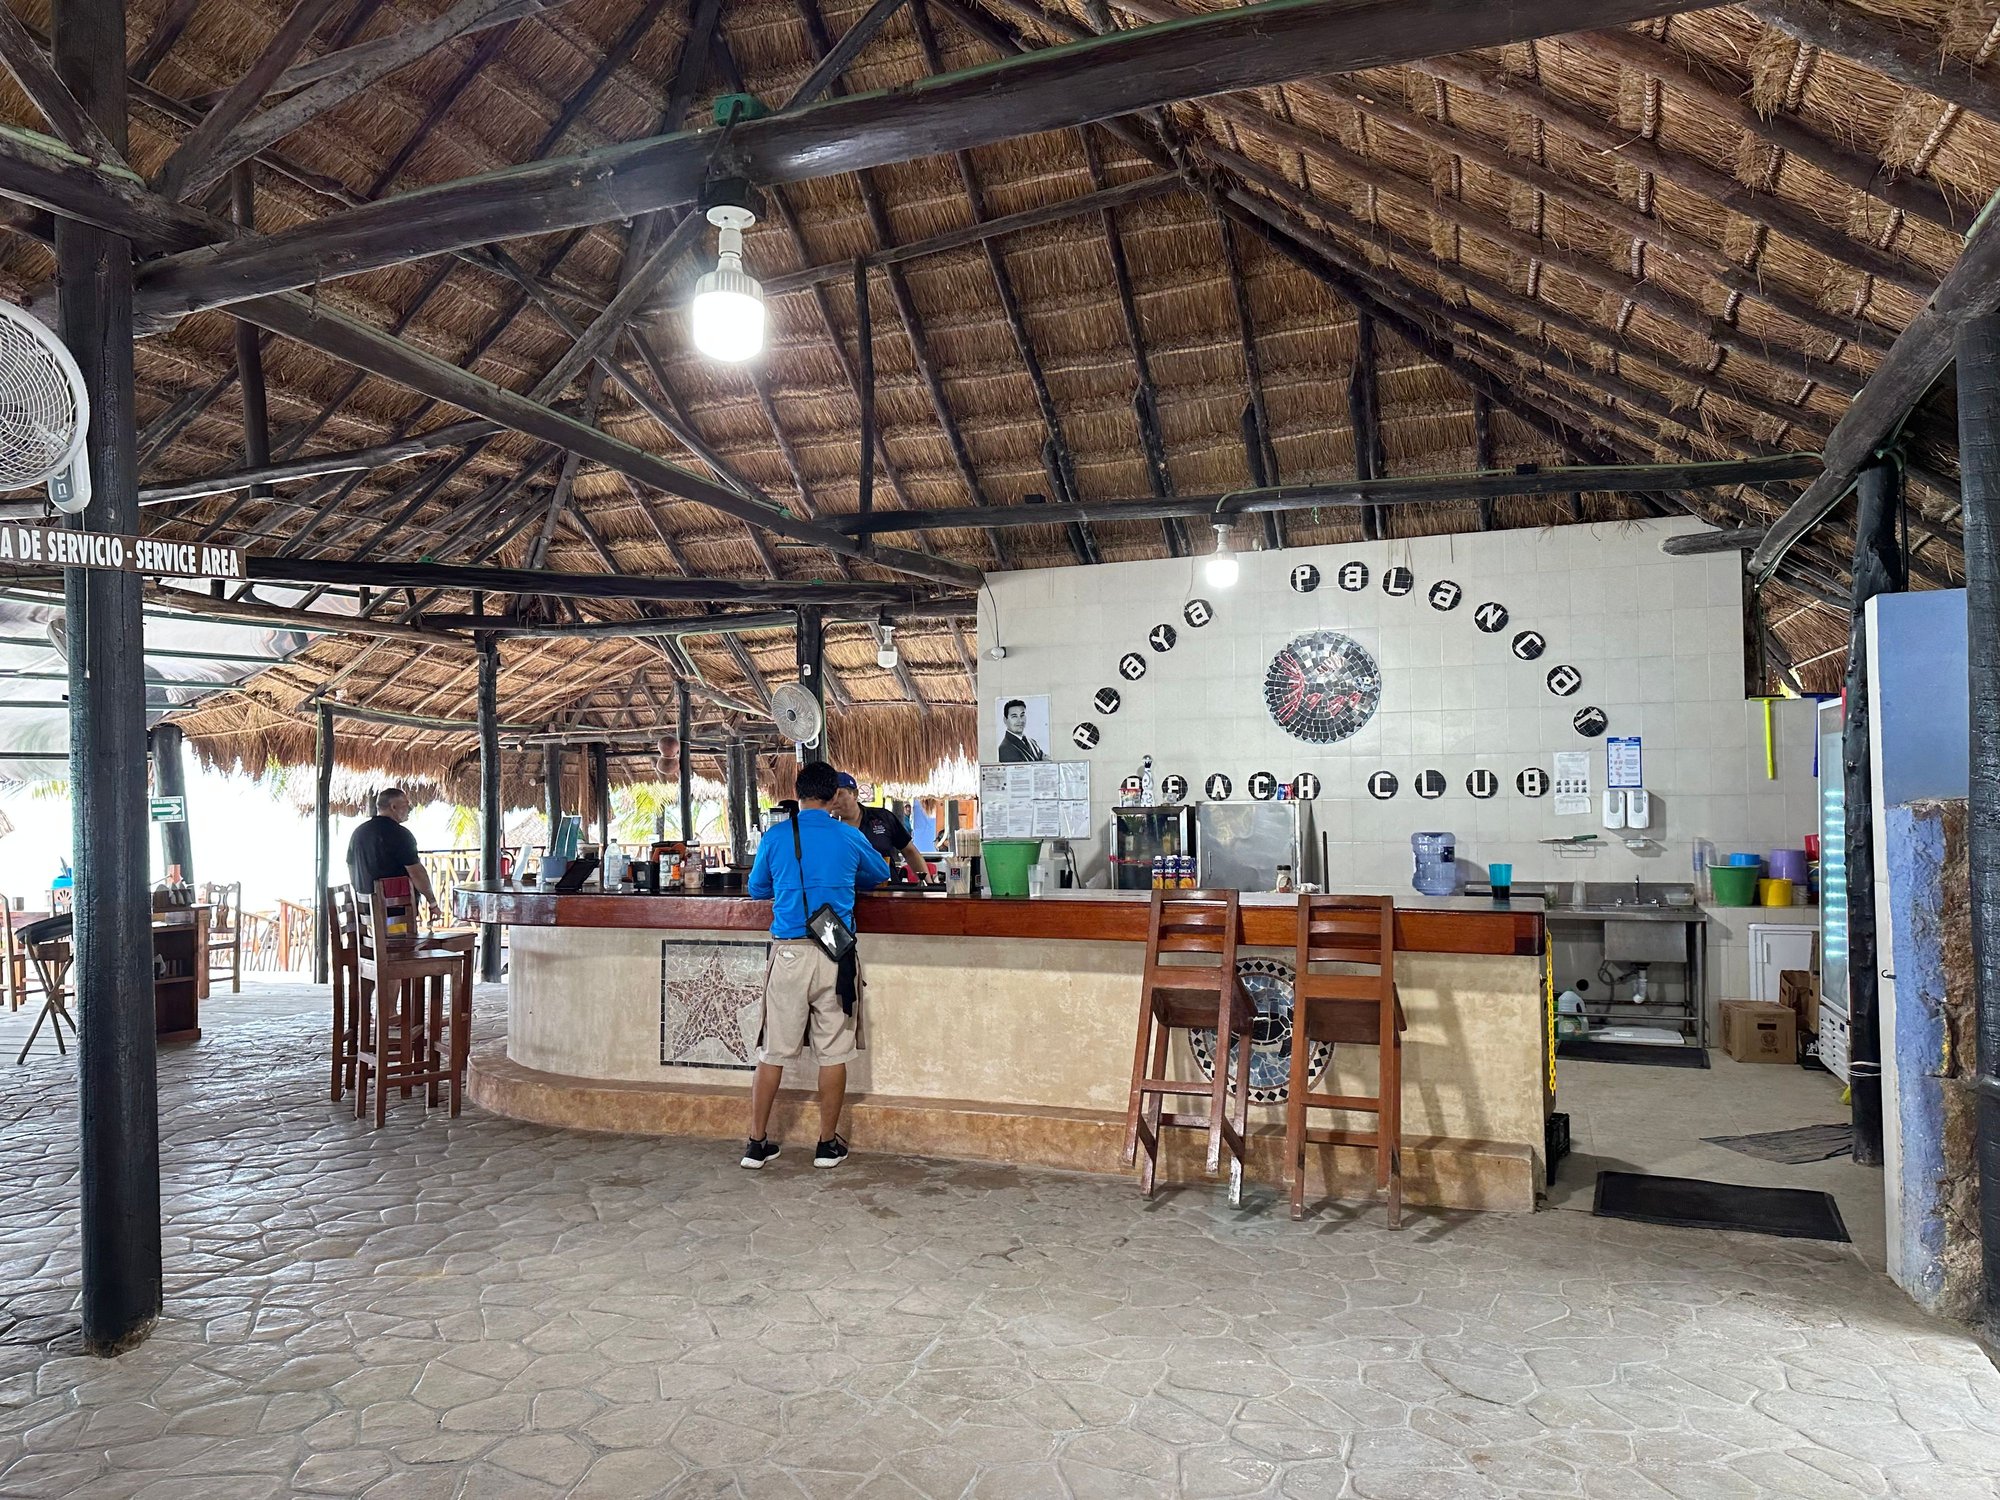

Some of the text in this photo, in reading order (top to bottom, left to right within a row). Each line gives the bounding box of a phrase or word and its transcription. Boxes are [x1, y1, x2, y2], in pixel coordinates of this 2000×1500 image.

[18, 528, 42, 561] DE
[48, 531, 124, 568] SERVICIO
[135, 540, 197, 574] SERVICE
[201, 547, 240, 577] AREA
[1375, 769, 1541, 797] CLUB
